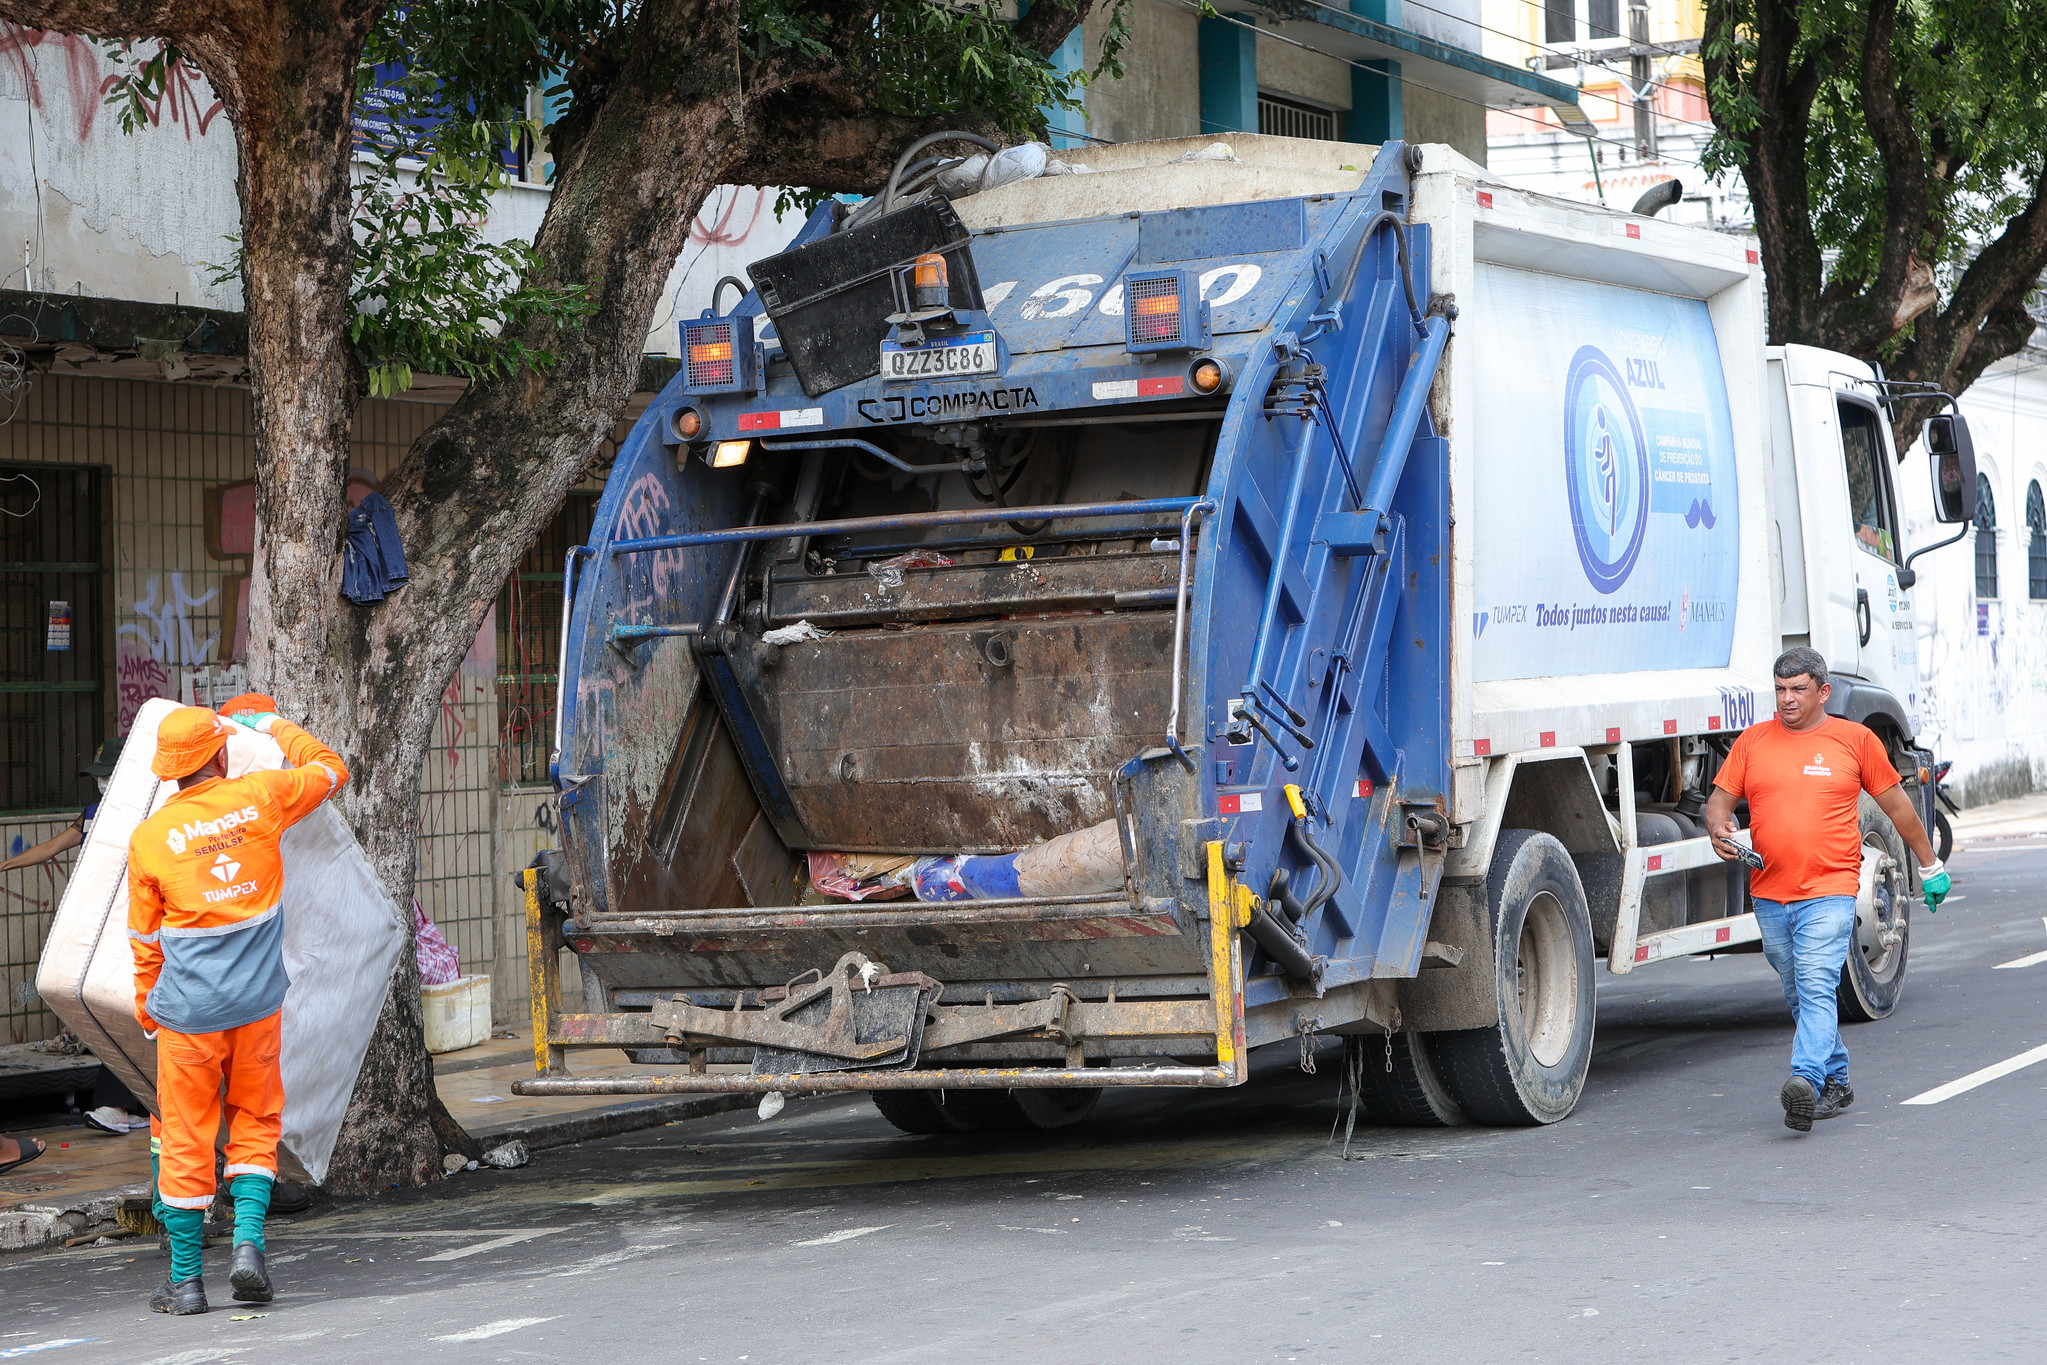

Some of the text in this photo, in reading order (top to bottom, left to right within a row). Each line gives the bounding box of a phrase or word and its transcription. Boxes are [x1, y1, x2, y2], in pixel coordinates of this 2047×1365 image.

[1611, 328, 1667, 356] NOVEMBRO
[891, 346, 983, 376] QZZ3C86
[1626, 357, 1666, 390] AZUL
[910, 387, 1039, 417] COMPACTA
[1654, 468, 1676, 482] CÂNCER
[1492, 604, 1528, 624] TUMPEX
[1536, 600, 1672, 631] Todos juntos nesta causa!
[1690, 602, 1726, 623] MANAUS
[183, 806, 259, 841] Manaus
[208, 827, 247, 844] Prefeitura
[194, 835, 244, 857] SEMULSP
[202, 880, 258, 903] TUMPEX
